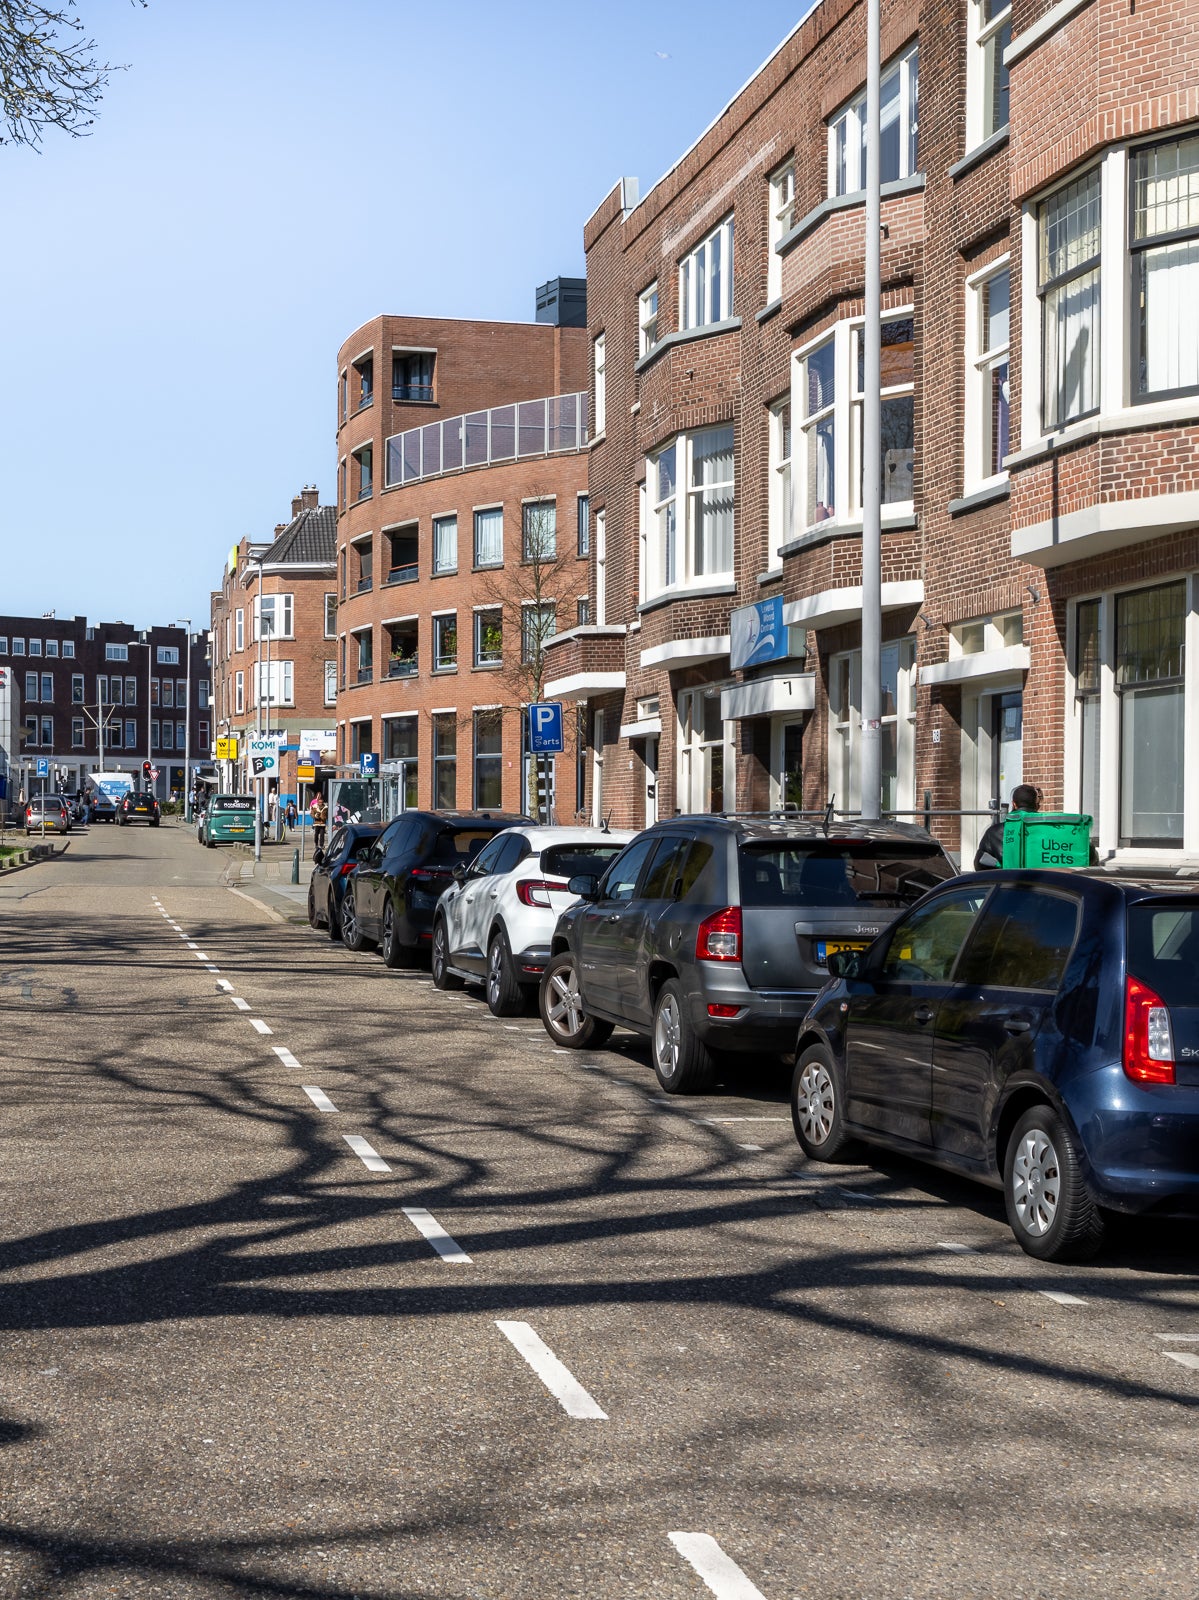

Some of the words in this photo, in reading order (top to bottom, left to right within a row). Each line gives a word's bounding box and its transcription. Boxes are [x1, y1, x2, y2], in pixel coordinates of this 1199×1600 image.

[537, 708, 554, 731] P
[251, 741, 275, 750] KOM!
[40, 761, 46, 770] P
[363, 754, 372, 766] P
[1041, 838, 1074, 852] Uber
[1041, 852, 1074, 865] Eats
[853, 925, 880, 935] Jeep
